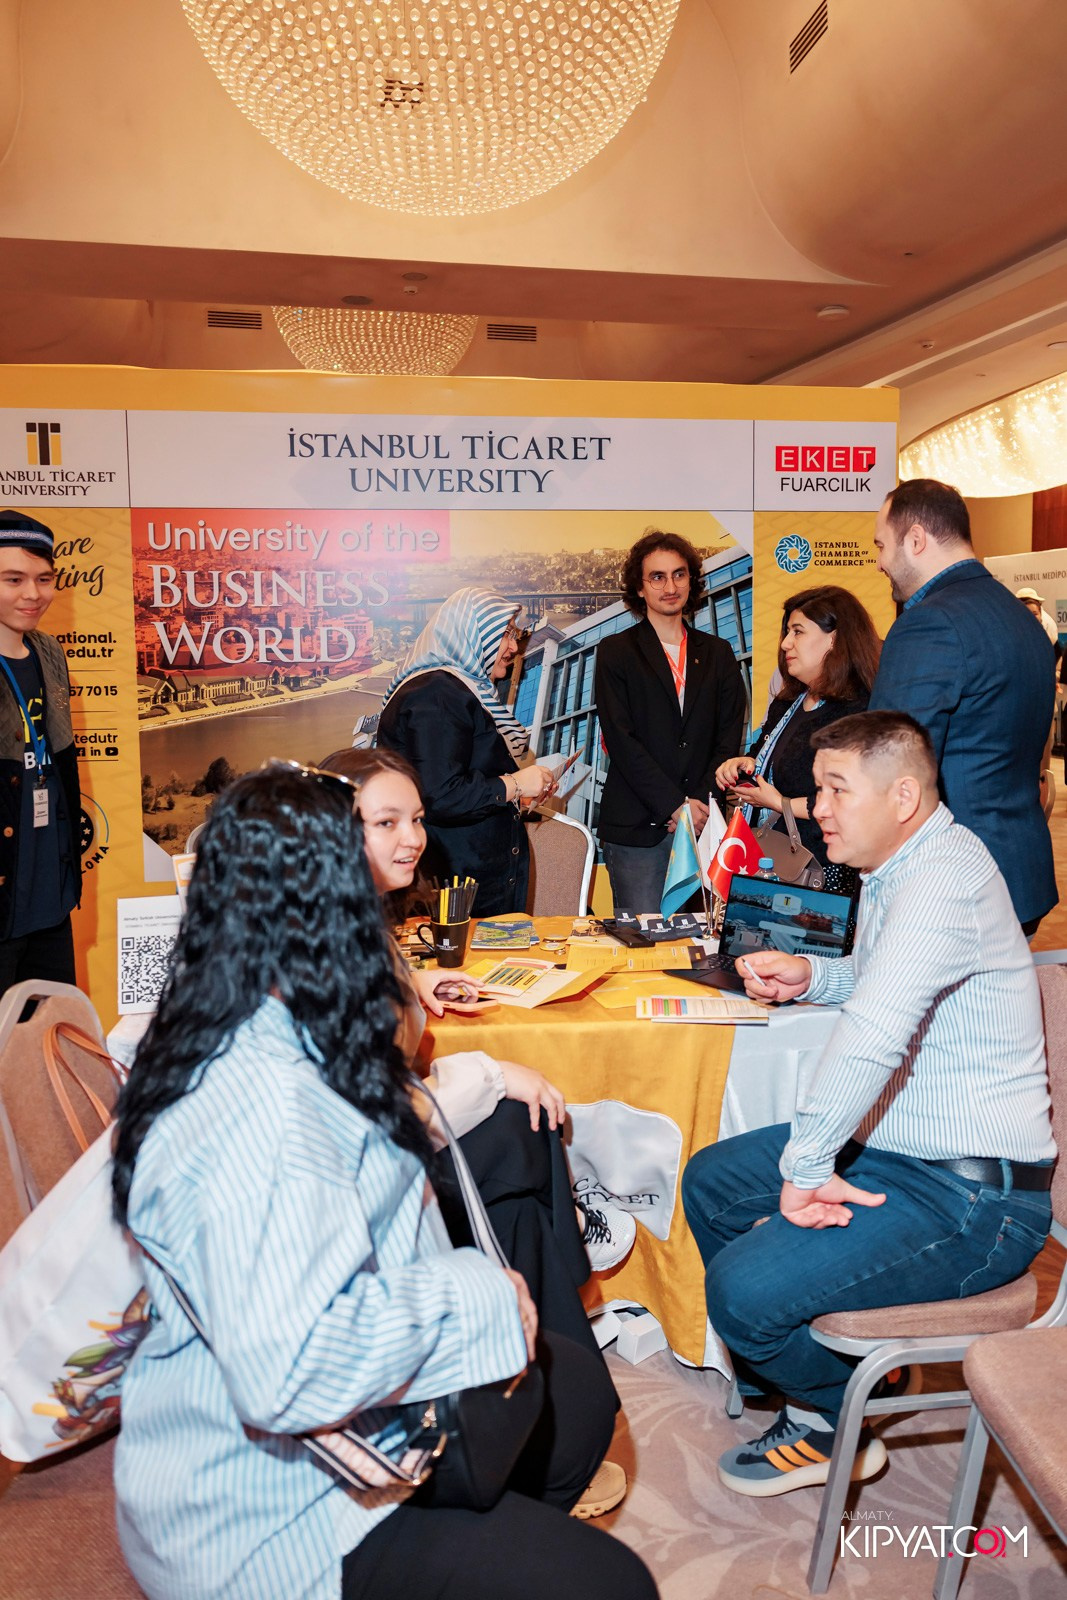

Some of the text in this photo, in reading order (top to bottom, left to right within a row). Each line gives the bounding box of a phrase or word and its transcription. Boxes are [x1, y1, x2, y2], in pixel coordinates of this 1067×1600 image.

[287, 427, 611, 461] İSTANBUL TİCARET
[780, 449, 872, 469] EKET
[49, 469, 116, 483] TİCARET
[348, 467, 553, 493] UNIVERSITY
[1, 484, 91, 496] UNIVERSITY
[780, 477, 871, 492] FUARCILIK
[147, 520, 440, 560] University of the
[814, 541, 860, 549] ISTANBUL
[814, 550, 861, 558] CHAMBER
[814, 559, 864, 567] COMMERCE
[148, 564, 390, 608] BUSINESS
[51, 631, 117, 644] ational.
[151, 621, 356, 664] WORLD
[66, 646, 114, 658] edu.tr
[74, 733, 118, 744] tedutr
